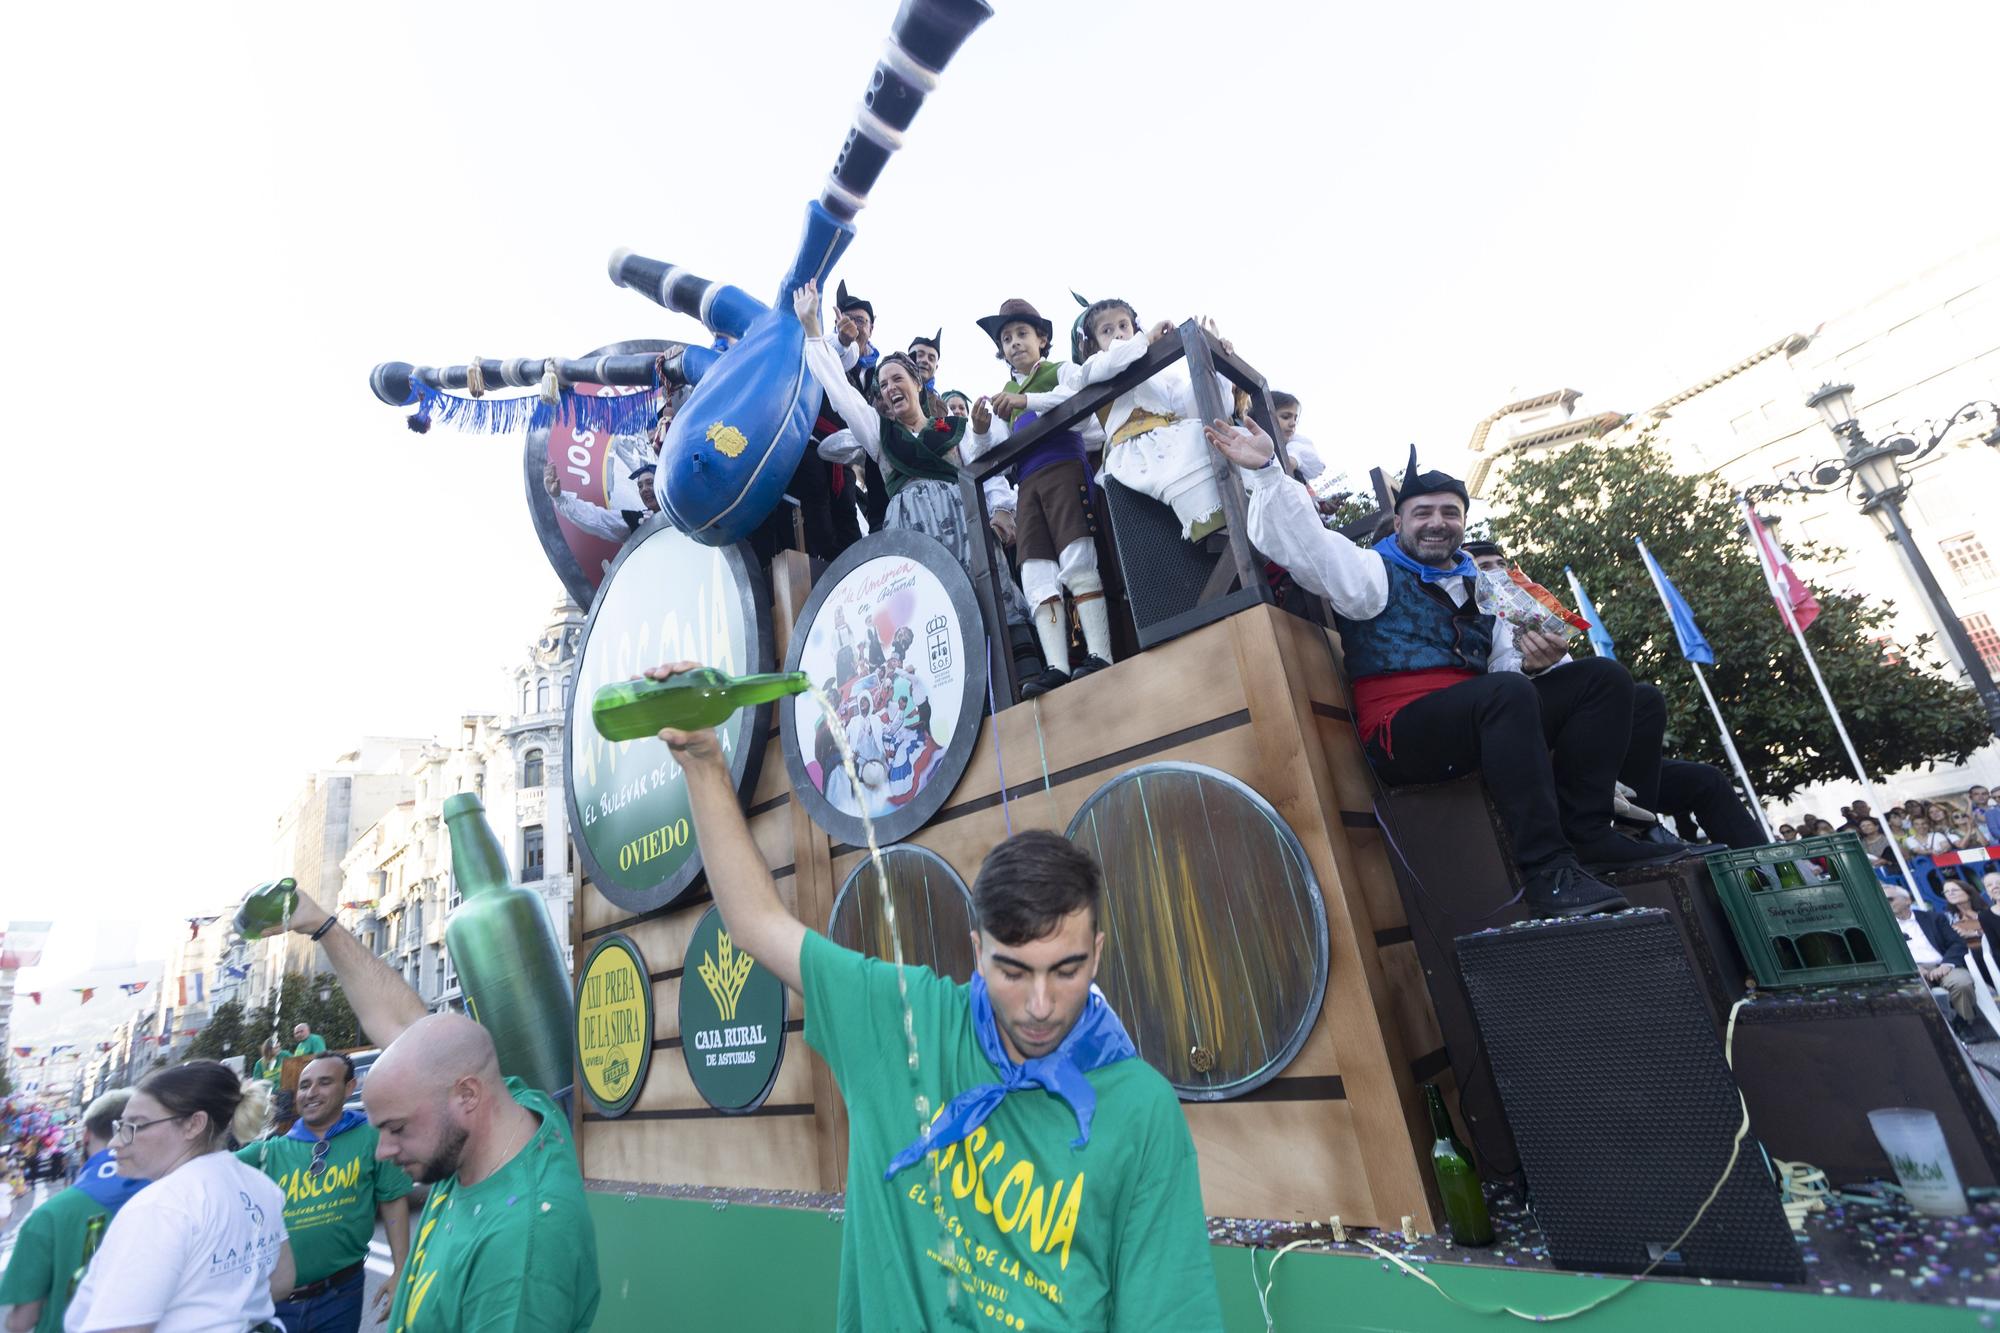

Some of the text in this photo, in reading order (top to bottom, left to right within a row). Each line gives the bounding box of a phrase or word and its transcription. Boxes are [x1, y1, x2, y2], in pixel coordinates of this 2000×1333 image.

[585, 804, 598, 827] EL
[599, 775, 648, 815] BULEVAR
[651, 761, 667, 788] DE
[619, 817, 690, 872] OVIEDO
[605, 966, 635, 1006] PREBA
[584, 1007, 640, 1050] DE LA SIDRA
[695, 1024, 767, 1050] CAJA RURAL
[705, 1050, 756, 1067] DE ASTURIAS
[908, 1183, 927, 1205] EL
[976, 1245, 998, 1267] DE
[1000, 1257, 1020, 1281] LA
